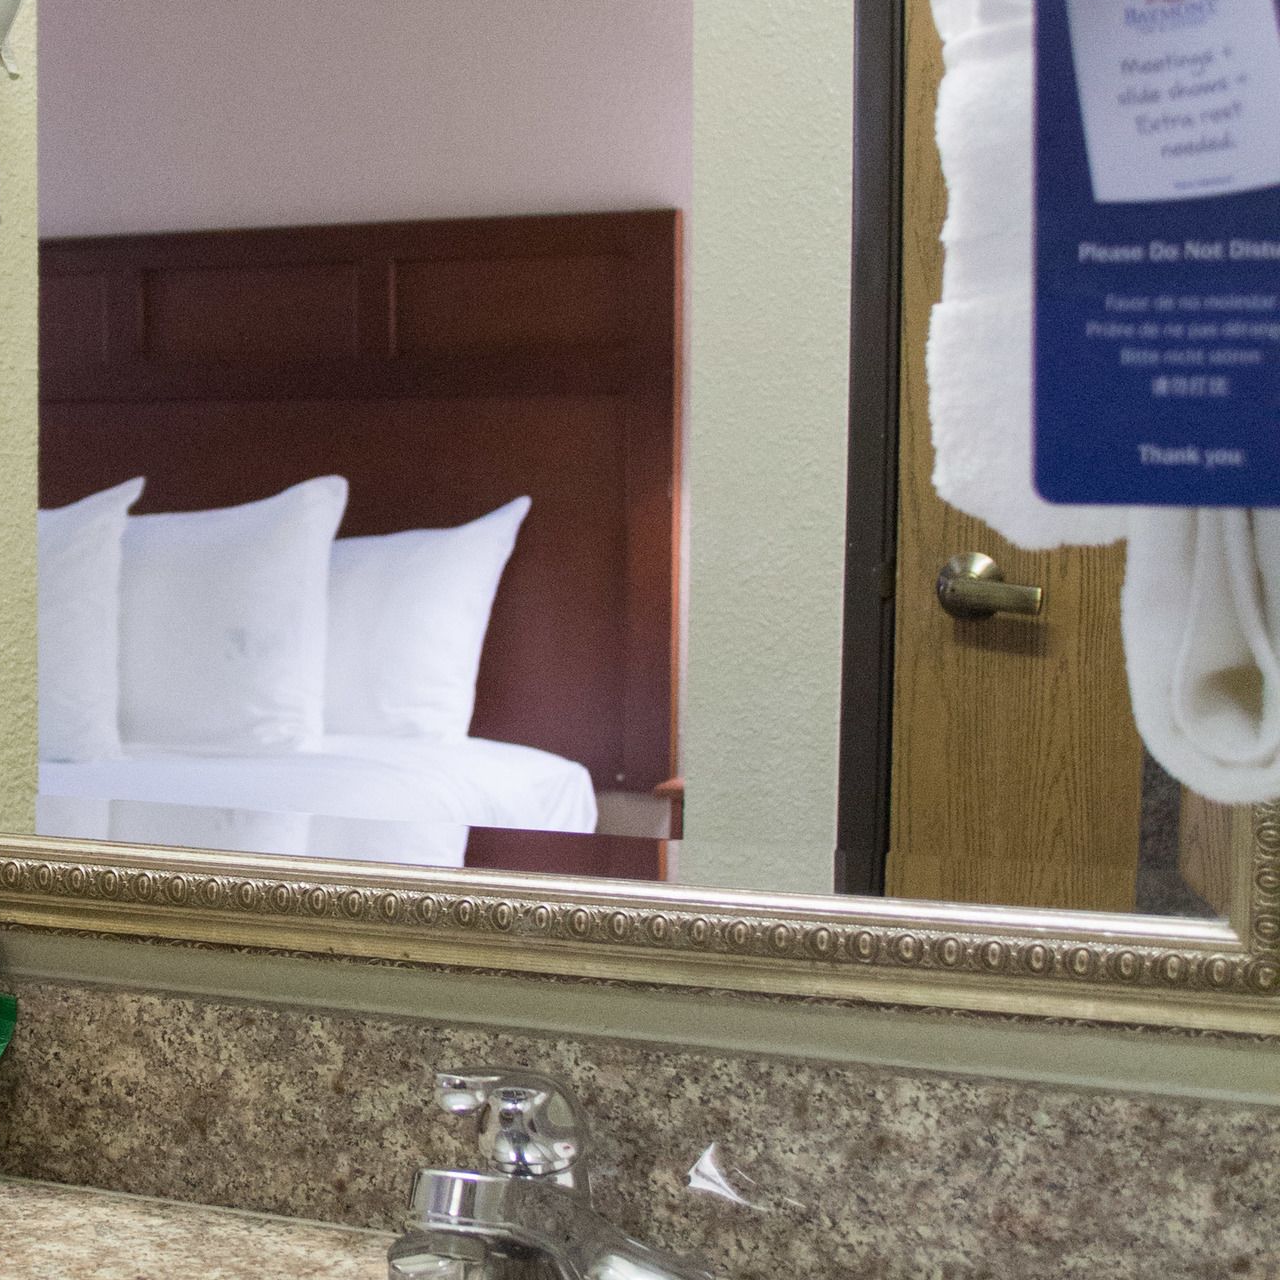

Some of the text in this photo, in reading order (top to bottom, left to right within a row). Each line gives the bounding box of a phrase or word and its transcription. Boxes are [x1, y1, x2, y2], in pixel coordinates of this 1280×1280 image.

[1078, 242, 1143, 263] Please
[1149, 240, 1179, 261] Do
[1183, 239, 1222, 260] Not
[1138, 444, 1243, 468] Thank you
